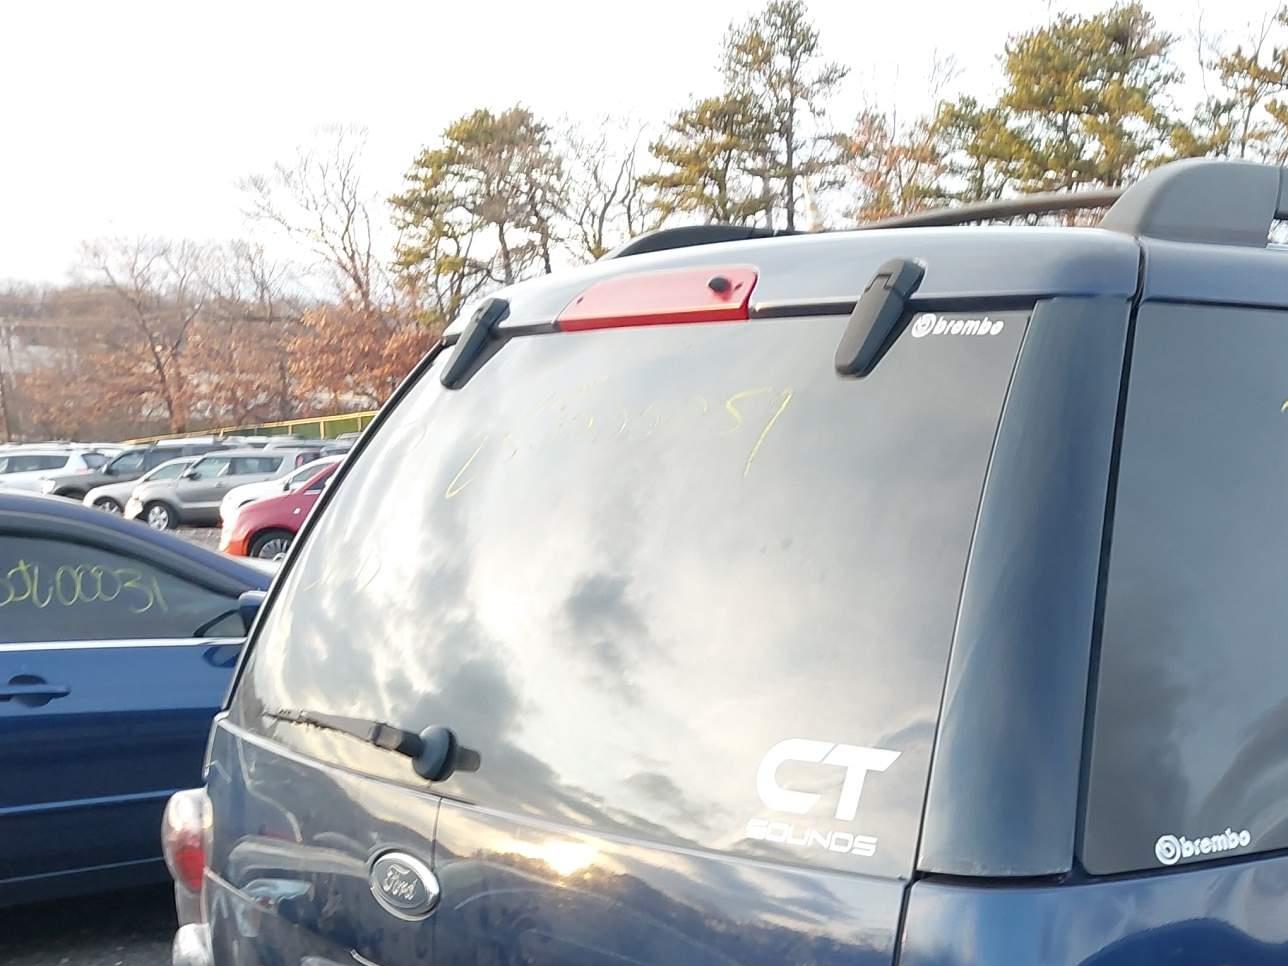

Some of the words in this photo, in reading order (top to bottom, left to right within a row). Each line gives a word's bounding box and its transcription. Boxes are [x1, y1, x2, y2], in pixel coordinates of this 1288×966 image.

[931, 316, 1004, 336] brembo
[756, 738, 902, 821] CT
[745, 818, 878, 857] SOUNDS
[1180, 827, 1251, 858] brembo
